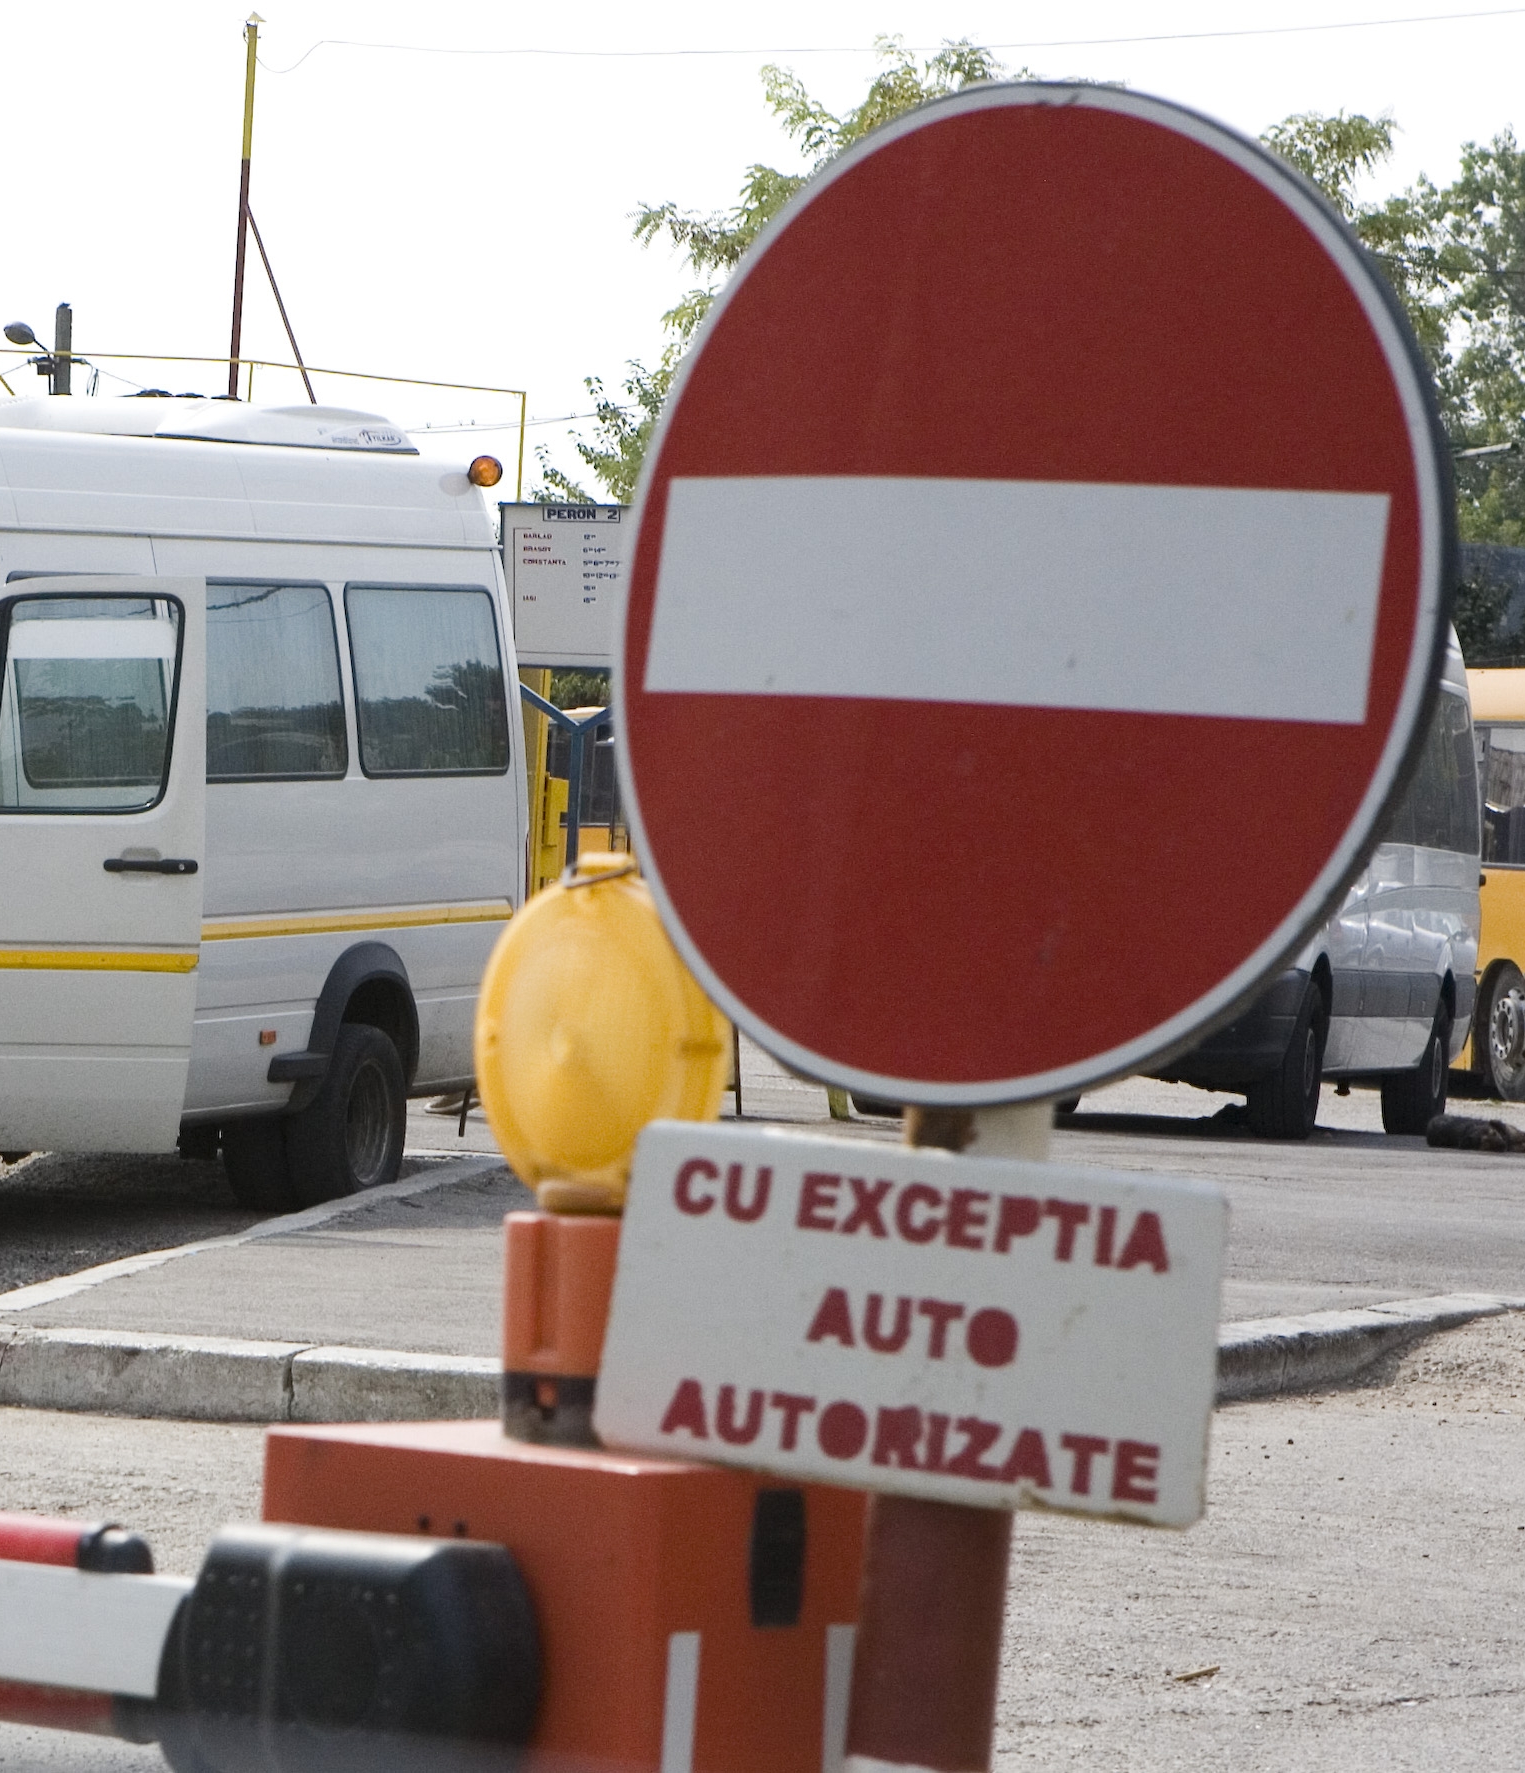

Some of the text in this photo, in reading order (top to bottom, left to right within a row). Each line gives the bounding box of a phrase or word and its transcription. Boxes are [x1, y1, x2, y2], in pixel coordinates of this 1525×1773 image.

[546, 508, 618, 520] PERON 2
[674, 1156, 1171, 1274] CU EXCEPTIA
[806, 1287, 1019, 1368] AUTO
[660, 1378, 1161, 1504] AUTORIZATE
